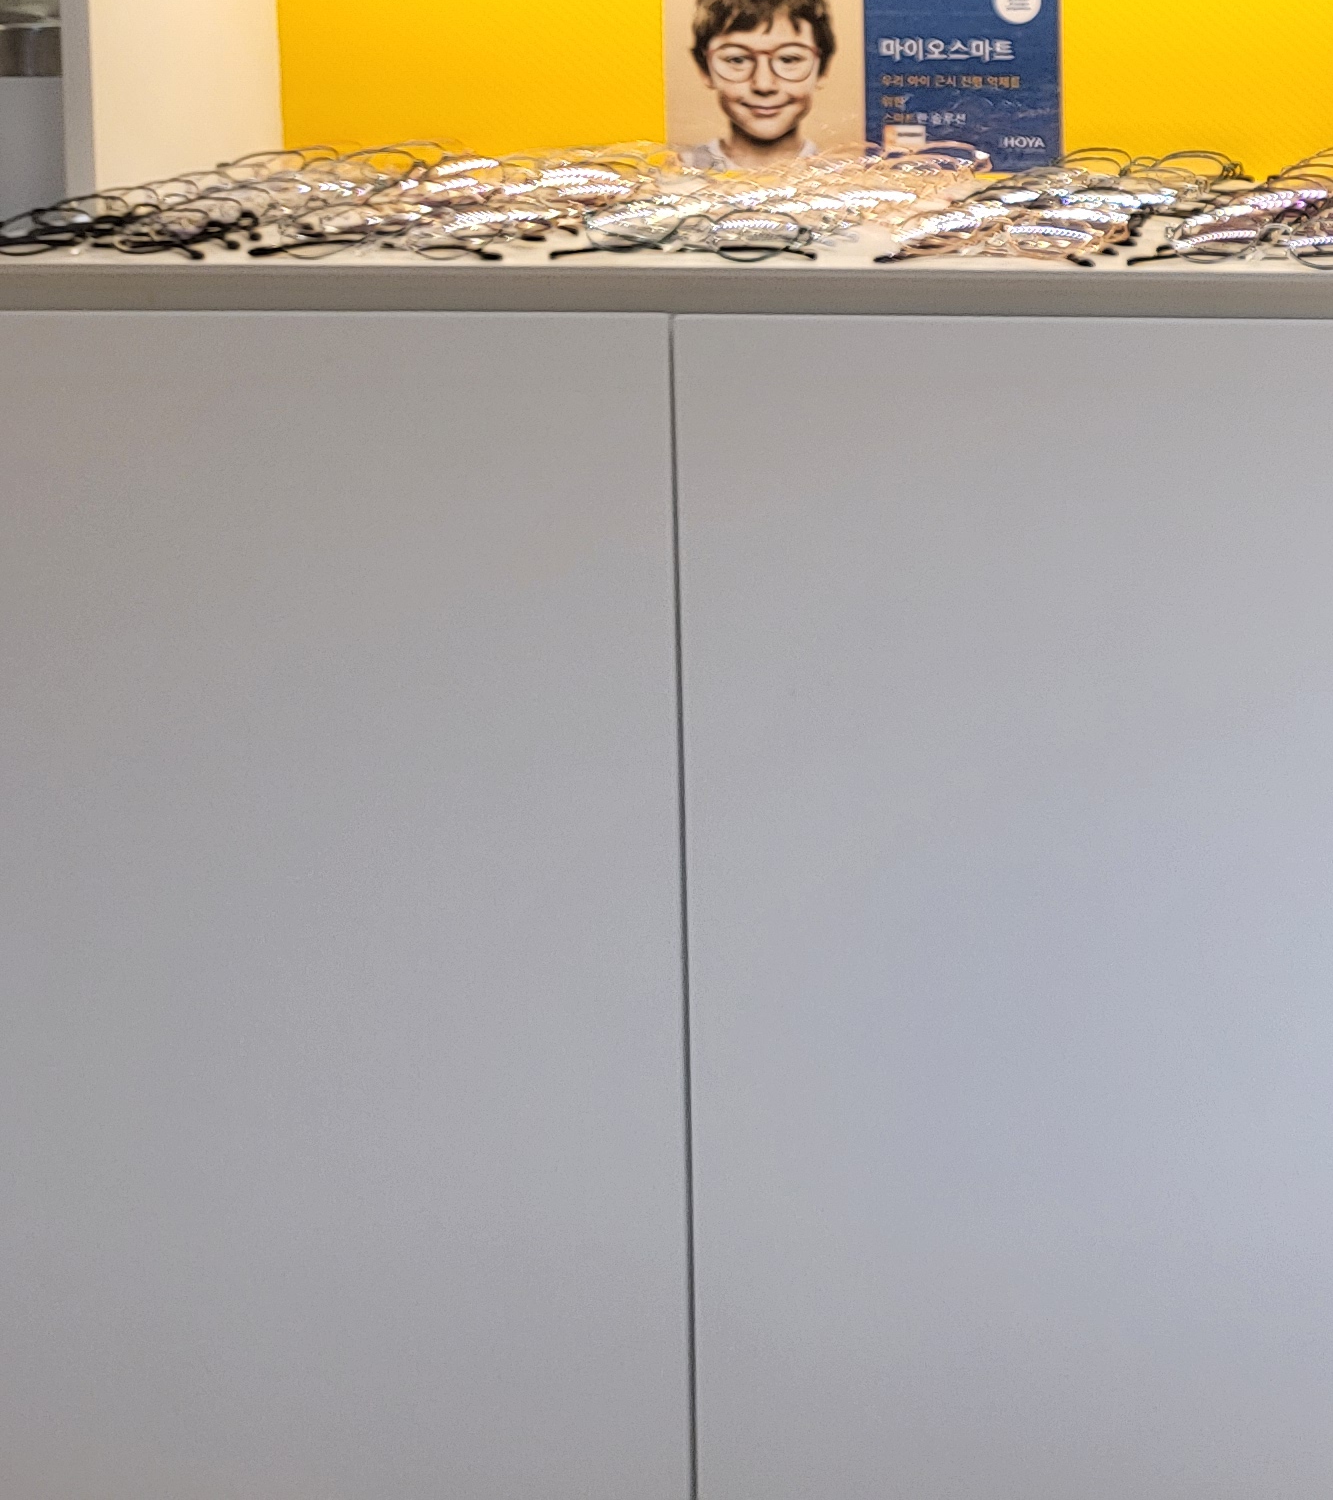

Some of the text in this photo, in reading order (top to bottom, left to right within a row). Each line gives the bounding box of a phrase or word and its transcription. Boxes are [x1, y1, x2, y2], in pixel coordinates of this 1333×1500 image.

[880, 37, 1015, 62] 마이오스마트
[881, 75, 903, 87] 우리
[907, 75, 930, 87] 아이
[934, 75, 955, 88] 근시
[1003, 136, 1045, 148] HOYA
